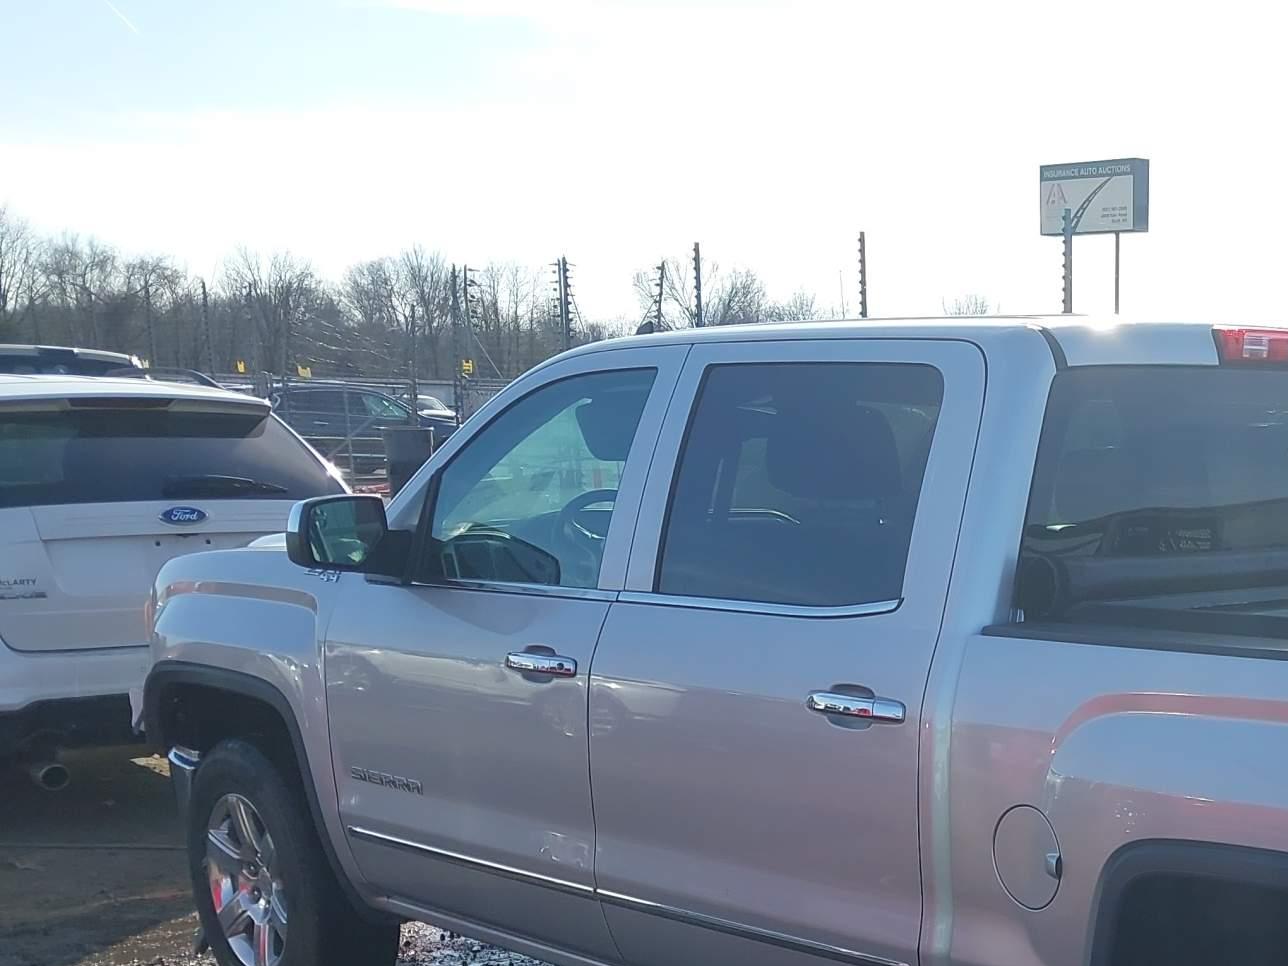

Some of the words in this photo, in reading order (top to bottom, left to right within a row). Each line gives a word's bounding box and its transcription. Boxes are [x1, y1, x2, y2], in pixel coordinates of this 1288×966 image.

[1043, 168, 1079, 178] INSURANCE
[1080, 167, 1097, 176] AUTO
[1098, 164, 1131, 174] AUCTIONS
[171, 509, 198, 521] Ford
[352, 766, 424, 795] SIERRA
